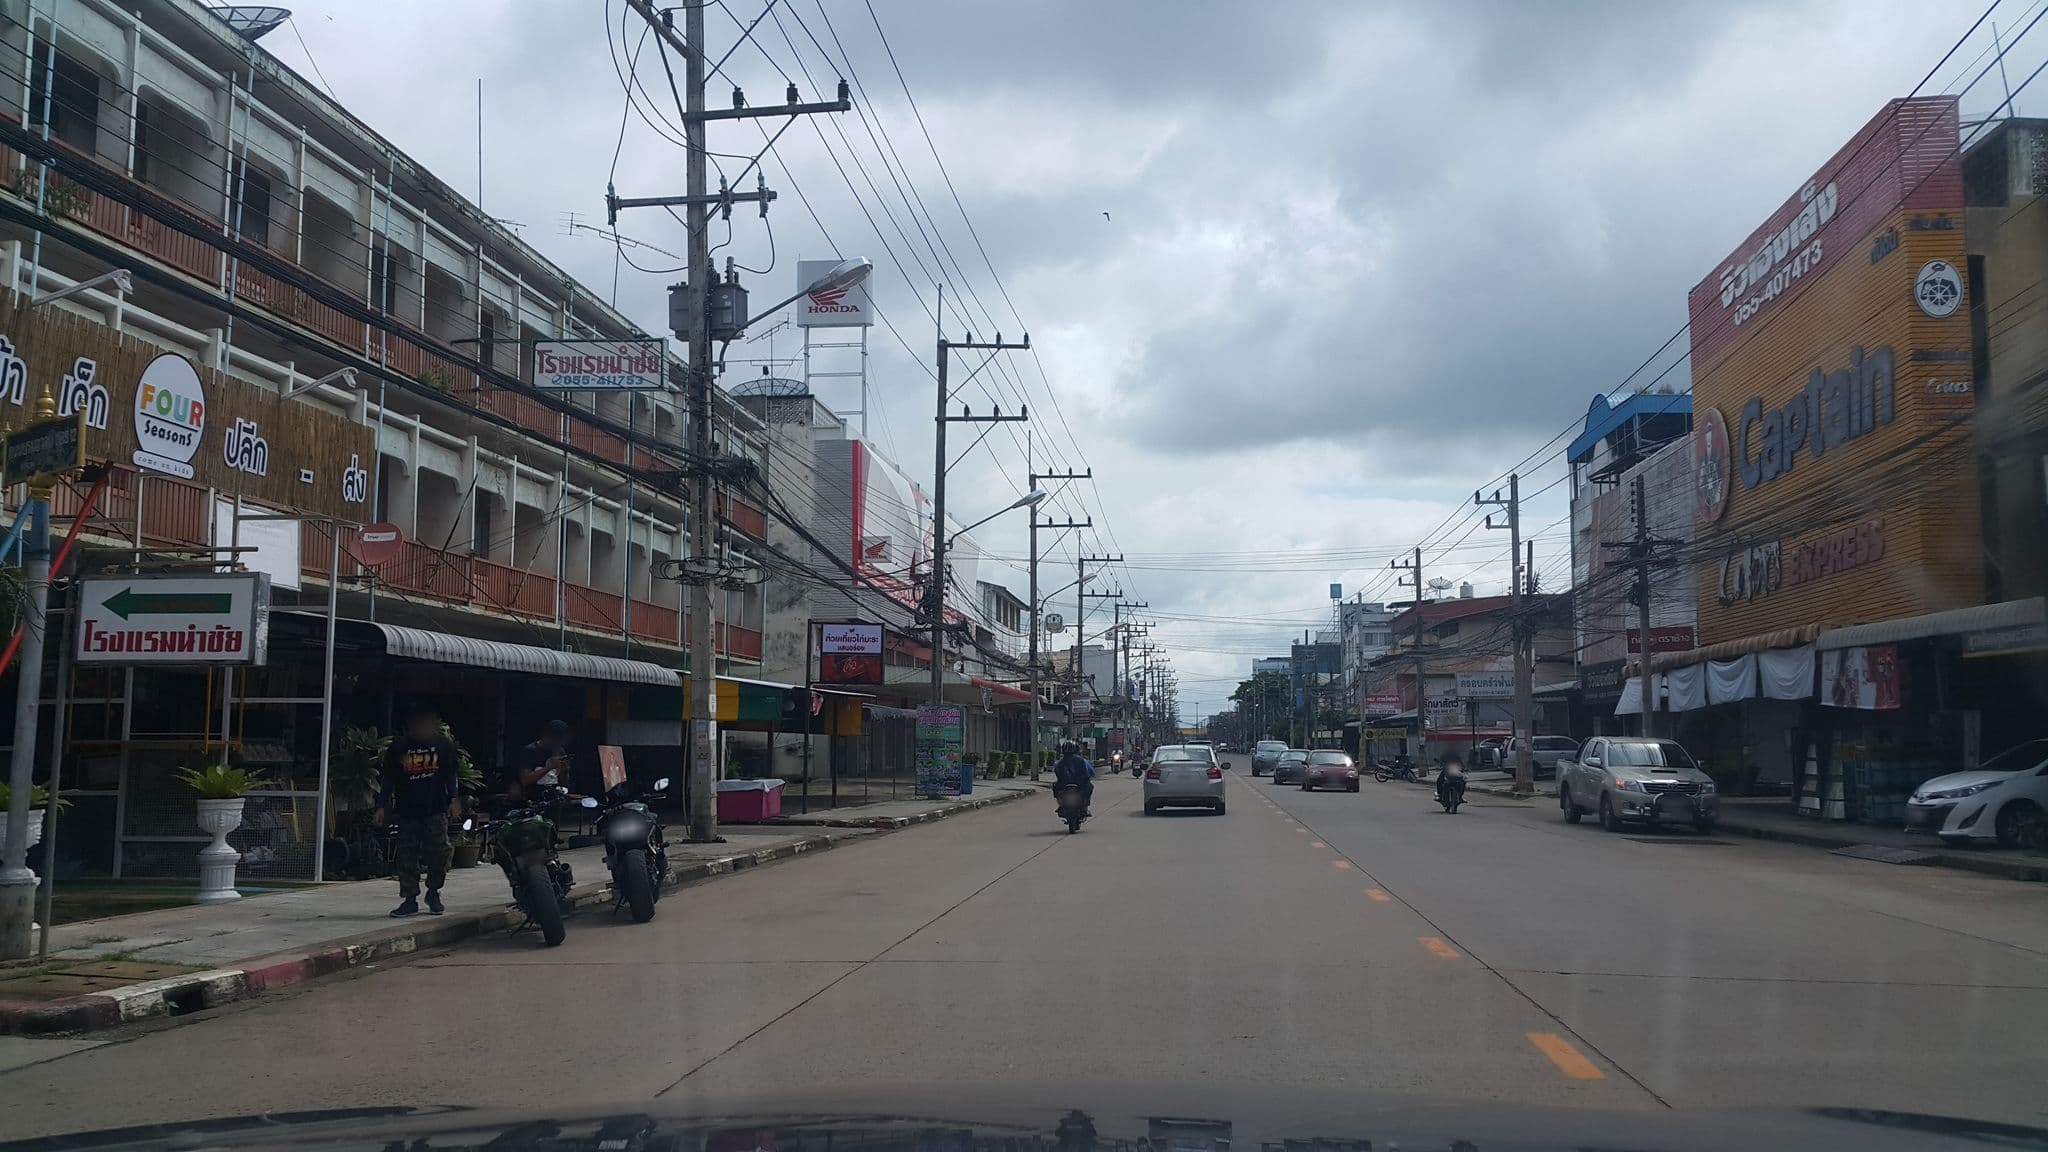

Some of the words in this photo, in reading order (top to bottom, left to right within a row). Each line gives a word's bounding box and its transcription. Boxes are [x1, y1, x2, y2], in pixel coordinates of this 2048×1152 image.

[1734, 239, 1823, 326] 055-407473
[807, 305, 861, 314] HONDA
[537, 341, 660, 374] โรงแรมนำชัย
[141, 382, 204, 428] FOUR
[1738, 343, 1895, 490] Captain
[57, 356, 109, 430] เด็ก
[224, 417, 268, 477] ปลีก
[343, 453, 367, 503] ส่ง
[83, 619, 243, 653] โรงแรมนำชัย
